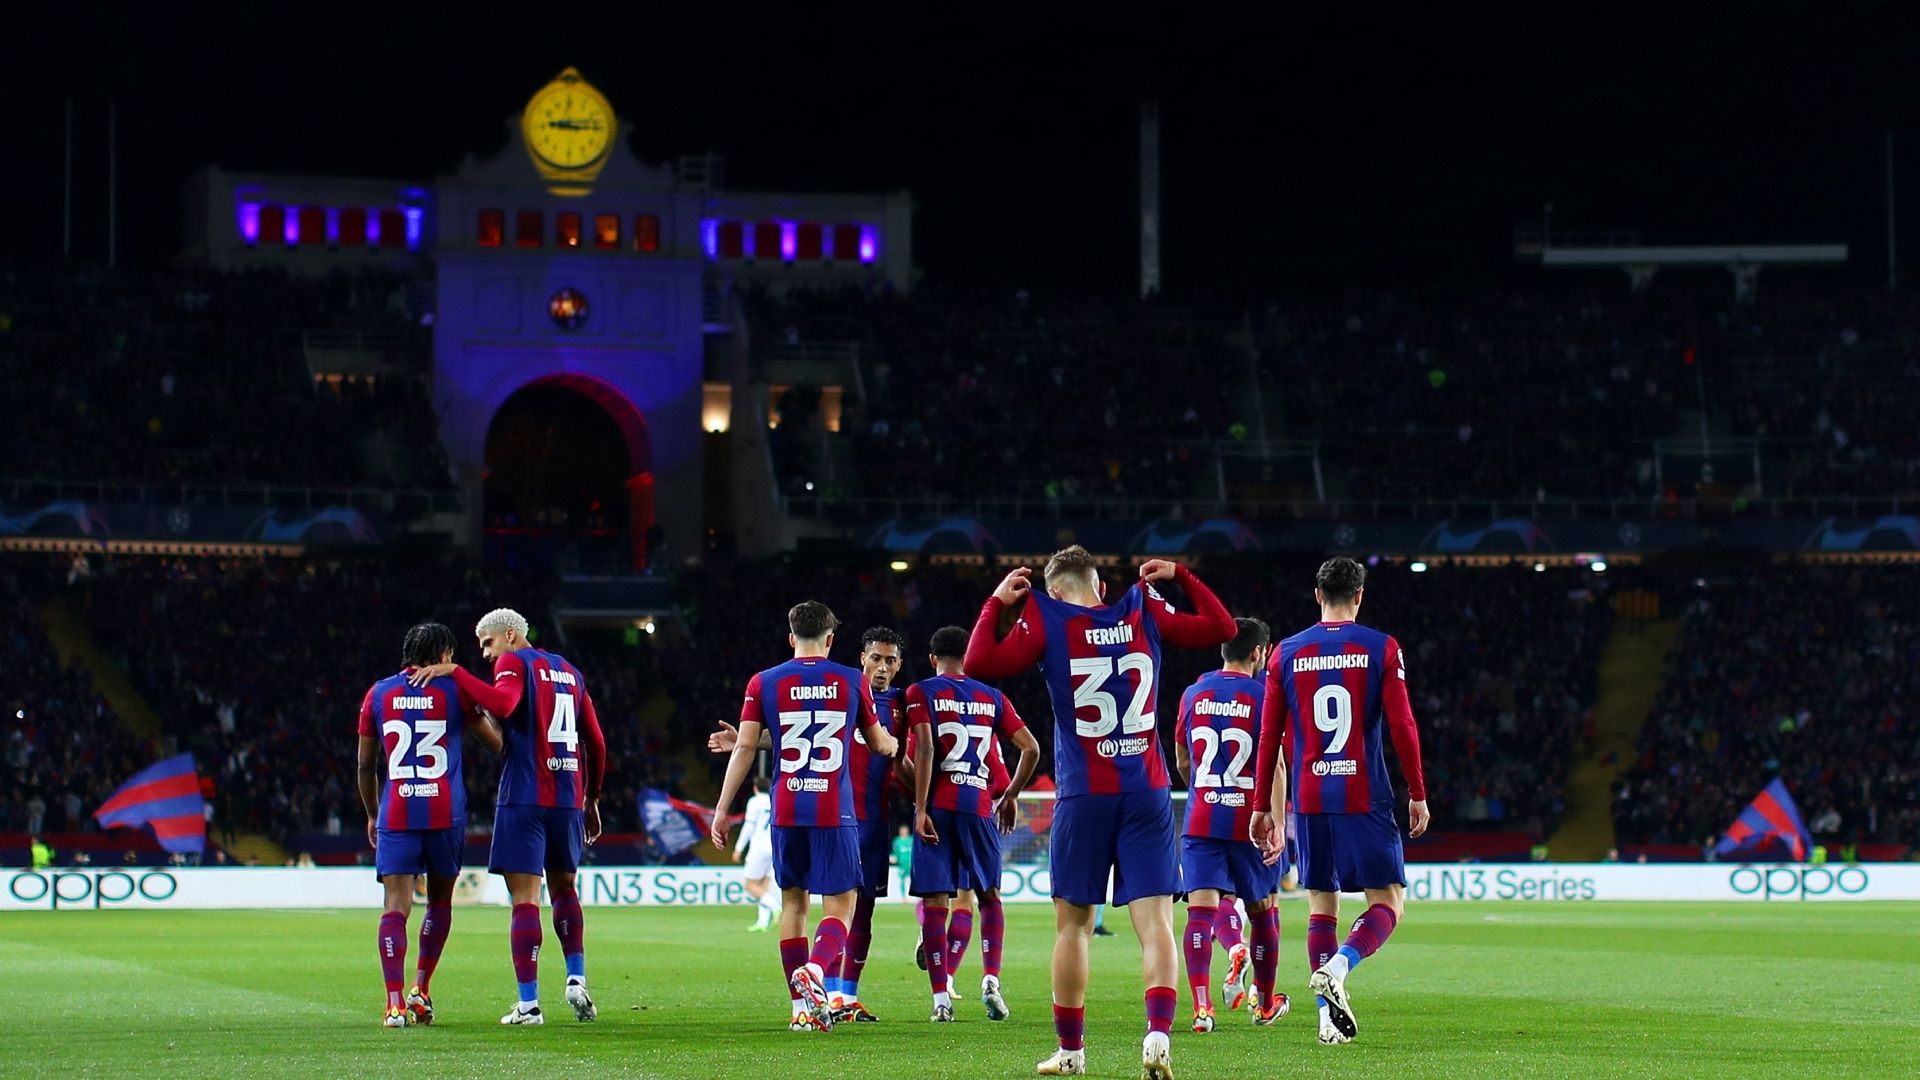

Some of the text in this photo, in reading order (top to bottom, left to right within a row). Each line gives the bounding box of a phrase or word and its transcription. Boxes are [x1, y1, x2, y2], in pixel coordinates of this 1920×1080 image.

[1085, 621, 1133, 645] FERMÍN
[790, 681, 838, 700] CUBARSÍ
[1293, 654, 1369, 673] LEWANDOWSKI
[547, 692, 579, 753] 4
[1070, 652, 1155, 738] 32
[1195, 698, 1251, 719] GÜNDOĞAN
[1313, 684, 1352, 754] 9
[382, 719, 449, 781] 23
[779, 710, 848, 773] 33
[937, 721, 993, 779] 27
[1190, 726, 1254, 789] 22
[593, 872, 643, 903] N3
[1441, 870, 1487, 899] N3
[1495, 869, 1597, 900] Series
